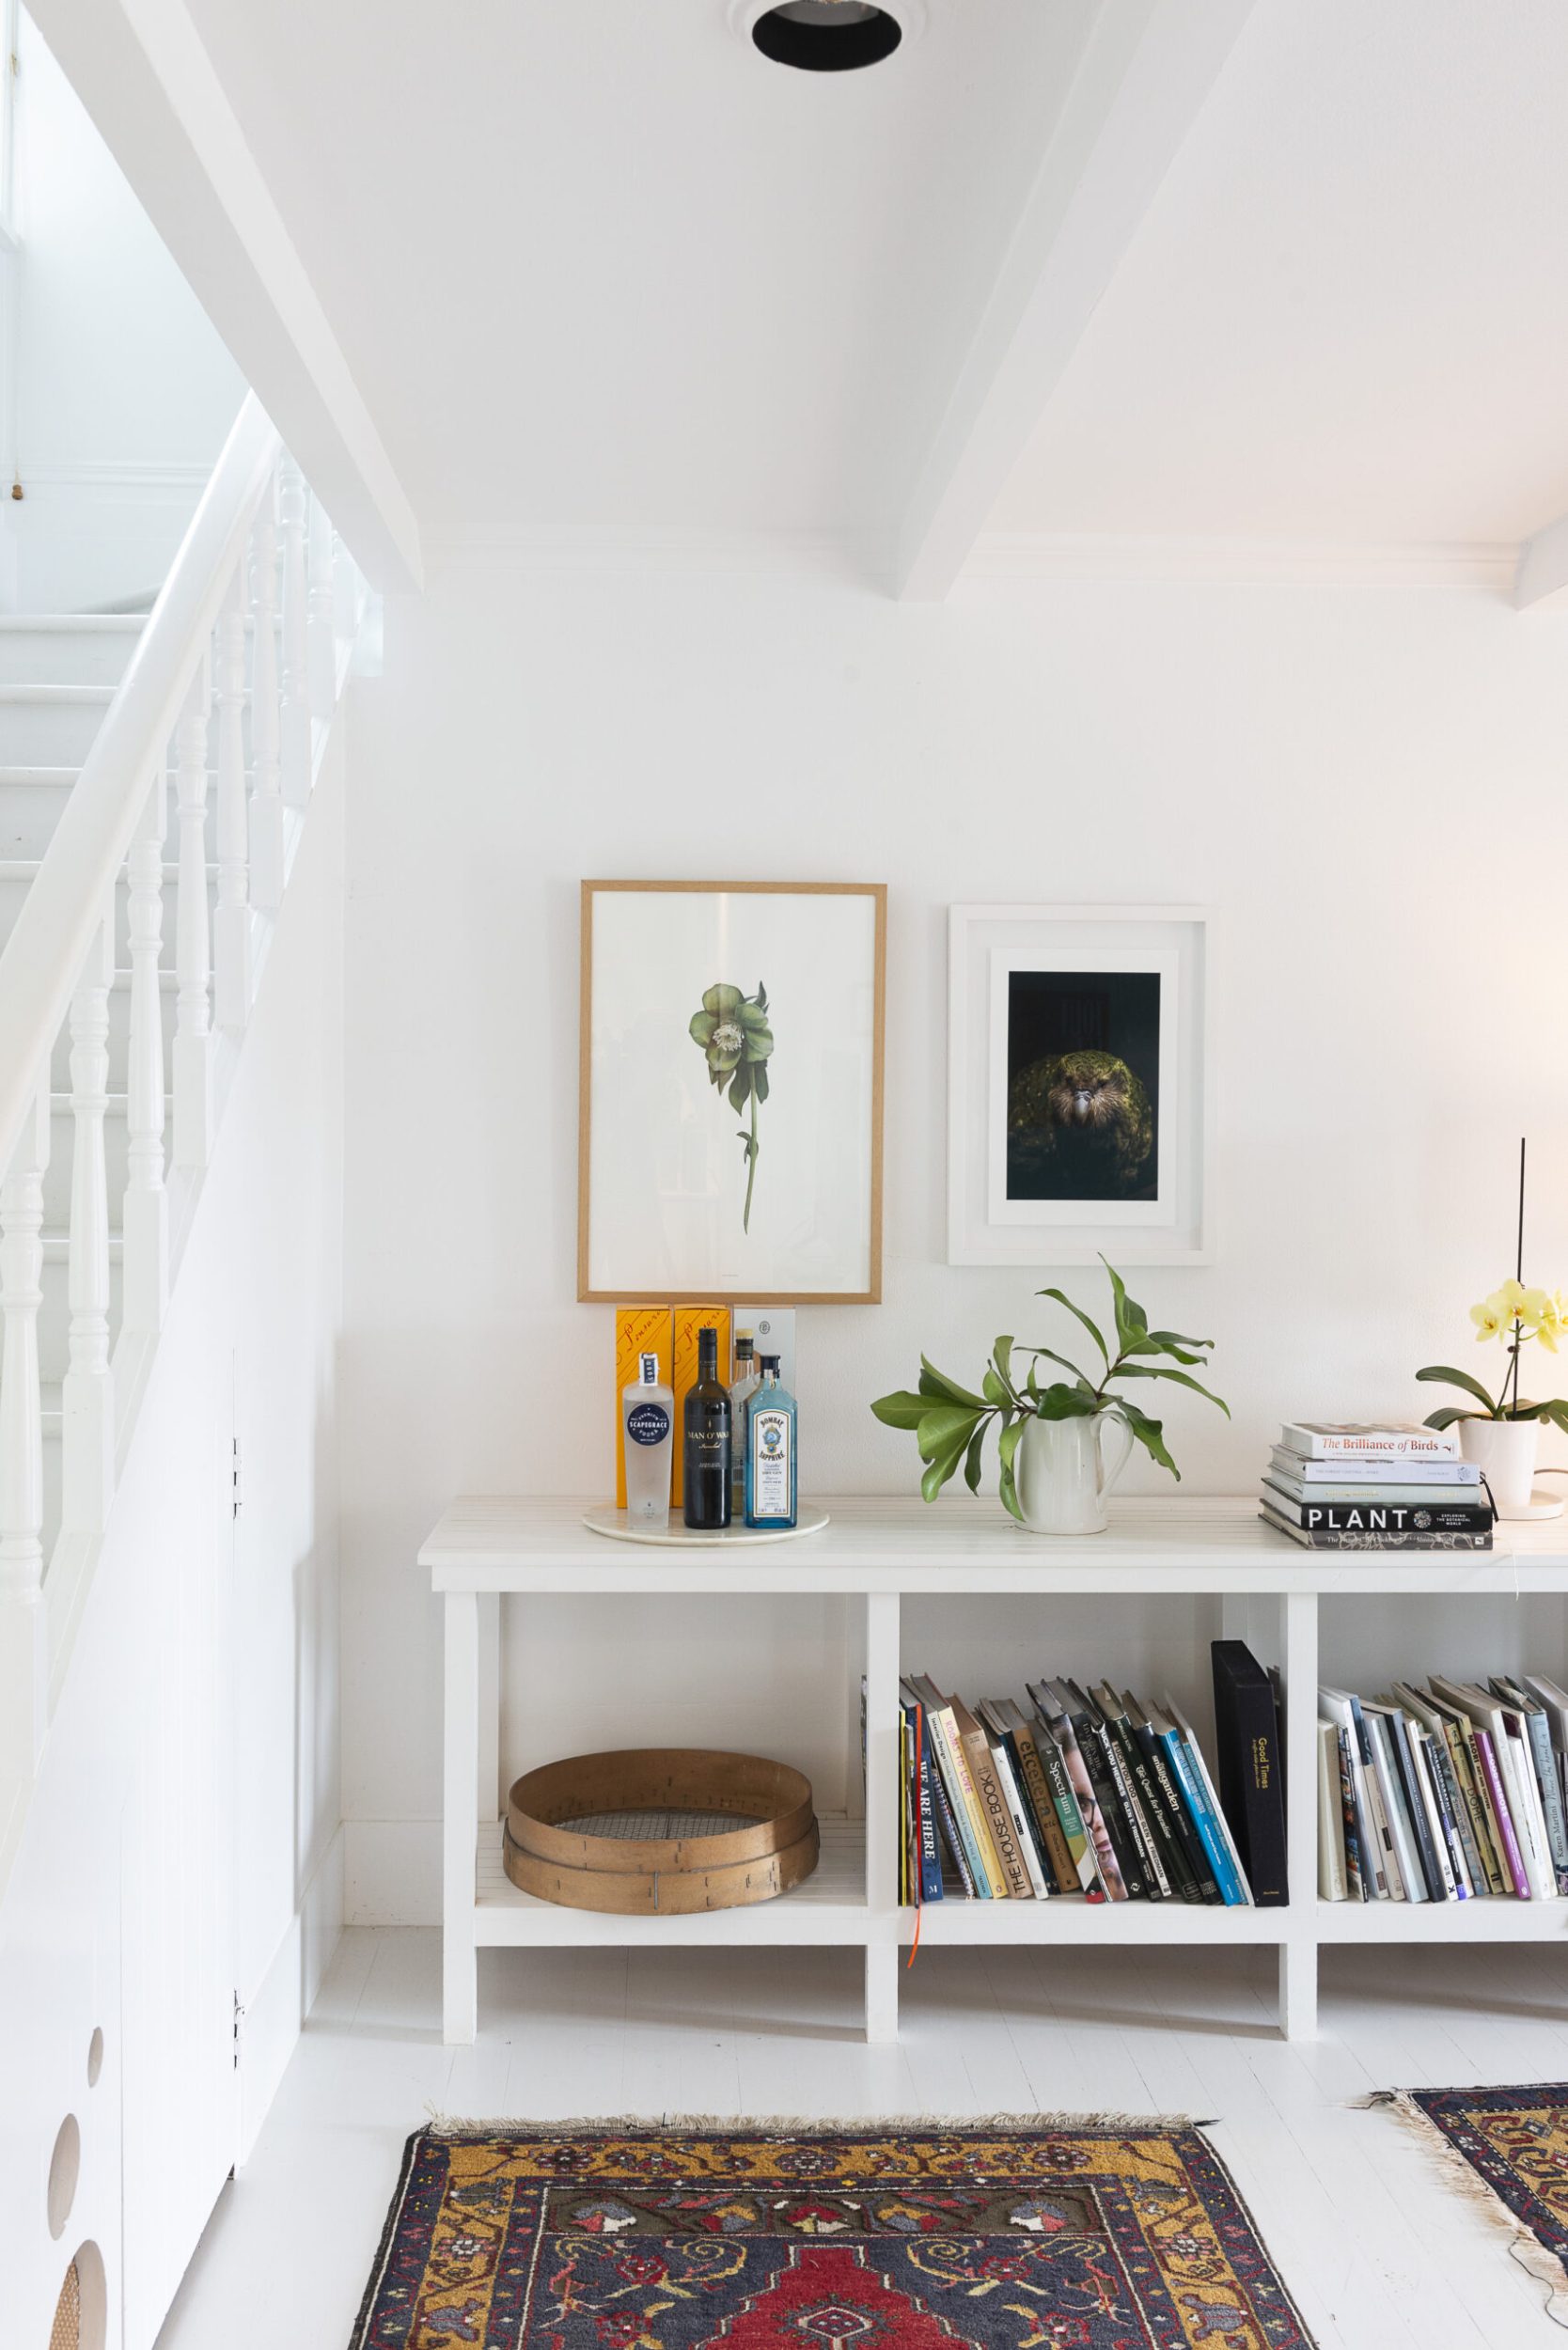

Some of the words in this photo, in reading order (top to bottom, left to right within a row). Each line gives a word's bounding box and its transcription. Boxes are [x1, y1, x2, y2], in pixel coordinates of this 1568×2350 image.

[760, 1418, 784, 1428] BOMBAY
[759, 1451, 785, 1462] SAPPHIRE
[1323, 1438, 1341, 1449] The
[1343, 1438, 1394, 1449] Brilliance
[1398, 1439, 1410, 1452] of
[1411, 1440, 1438, 1450] Birds
[1309, 1509, 1408, 1528] PLANT
[930, 1717, 941, 1739] Interior
[935, 1740, 948, 1760] Design
[944, 1719, 961, 1752] ROOMS
[954, 1754, 964, 1766] TO
[959, 1769, 974, 1794] LOVE
[1123, 1738, 1133, 1752] KING
[1258, 1737, 1269, 1762] Good
[1018, 1738, 1055, 1818] etcetera
[1105, 1749, 1115, 1766] YOU
[1111, 1766, 1125, 1797] HEROES
[1134, 1763, 1148, 1778] The
[1260, 1764, 1270, 1789] Times
[1429, 1745, 1452, 1811] CINEMATOGRAPHY
[1466, 1733, 1480, 1762] MAORI
[1482, 1788, 1490, 1810] CULTURE
[979, 1773, 1002, 1814] BOOK
[1048, 1760, 1075, 1815] Spectrum
[1141, 1778, 1155, 1798] Quest
[1485, 1752, 1499, 1779] FOOD
[1493, 1779, 1510, 1818] HEROES
[1544, 1778, 1557, 1800] Where
[920, 1790, 932, 1816] ARE
[1111, 1743, 1123, 1762] FUCK
[1119, 1762, 1131, 1781] YOU
[1125, 1781, 1137, 1798] TOO
[1139, 1820, 1151, 1838] GLEN
[1148, 1846, 1165, 1878] FRIEDMAN
[1149, 1797, 1160, 1810] for
[1466, 1787, 1482, 1823] DOME
[1121, 1801, 1133, 1818] GLEN
[1129, 1825, 1147, 1857] FRIEDMAN
[1153, 1808, 1172, 1841] Paradise
[1548, 1805, 1560, 1834] Martini
[922, 1823, 935, 1859] HERE
[993, 1815, 1017, 1864] HOUSE
[1553, 1835, 1564, 1857] Karen
[1008, 1865, 1026, 1893] THE
